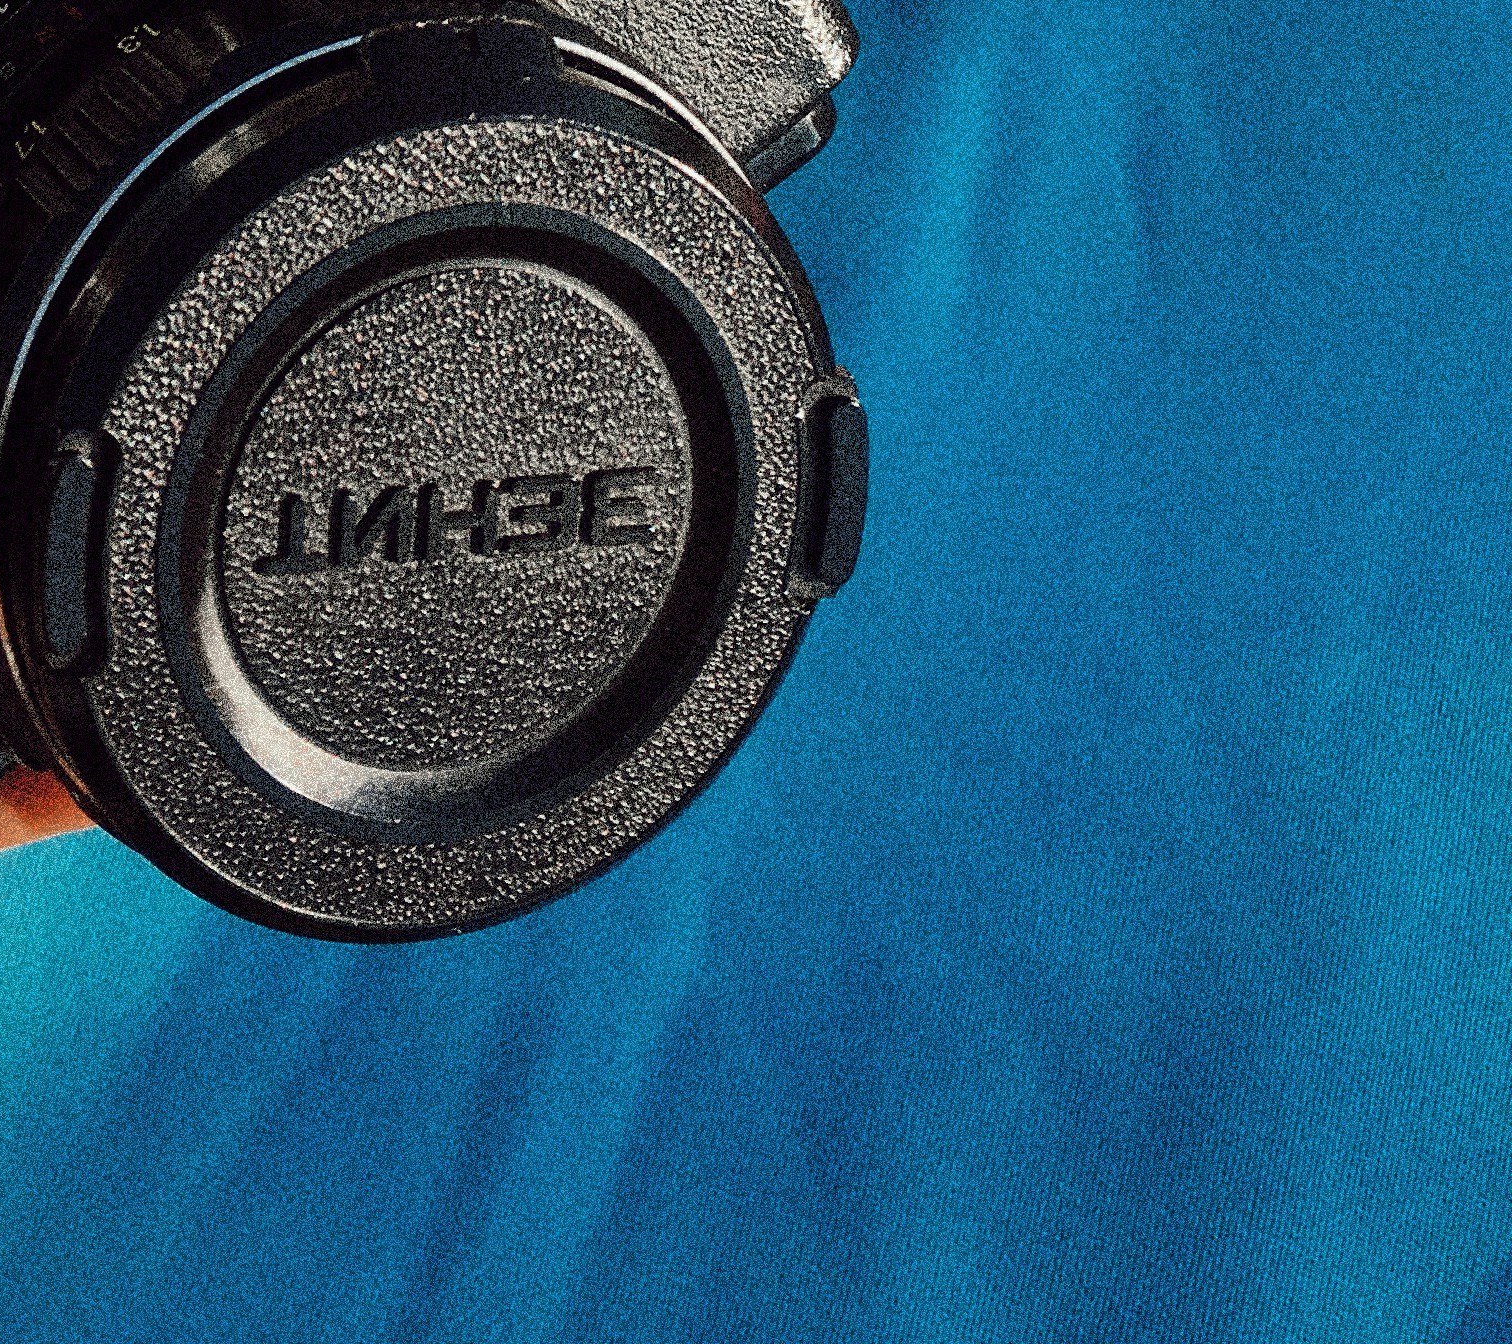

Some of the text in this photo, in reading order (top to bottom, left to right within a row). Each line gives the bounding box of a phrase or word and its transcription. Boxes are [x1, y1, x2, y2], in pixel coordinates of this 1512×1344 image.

[13, 21, 162, 162] 1,3 1,7
[254, 465, 657, 577] ЗЕНИТ
